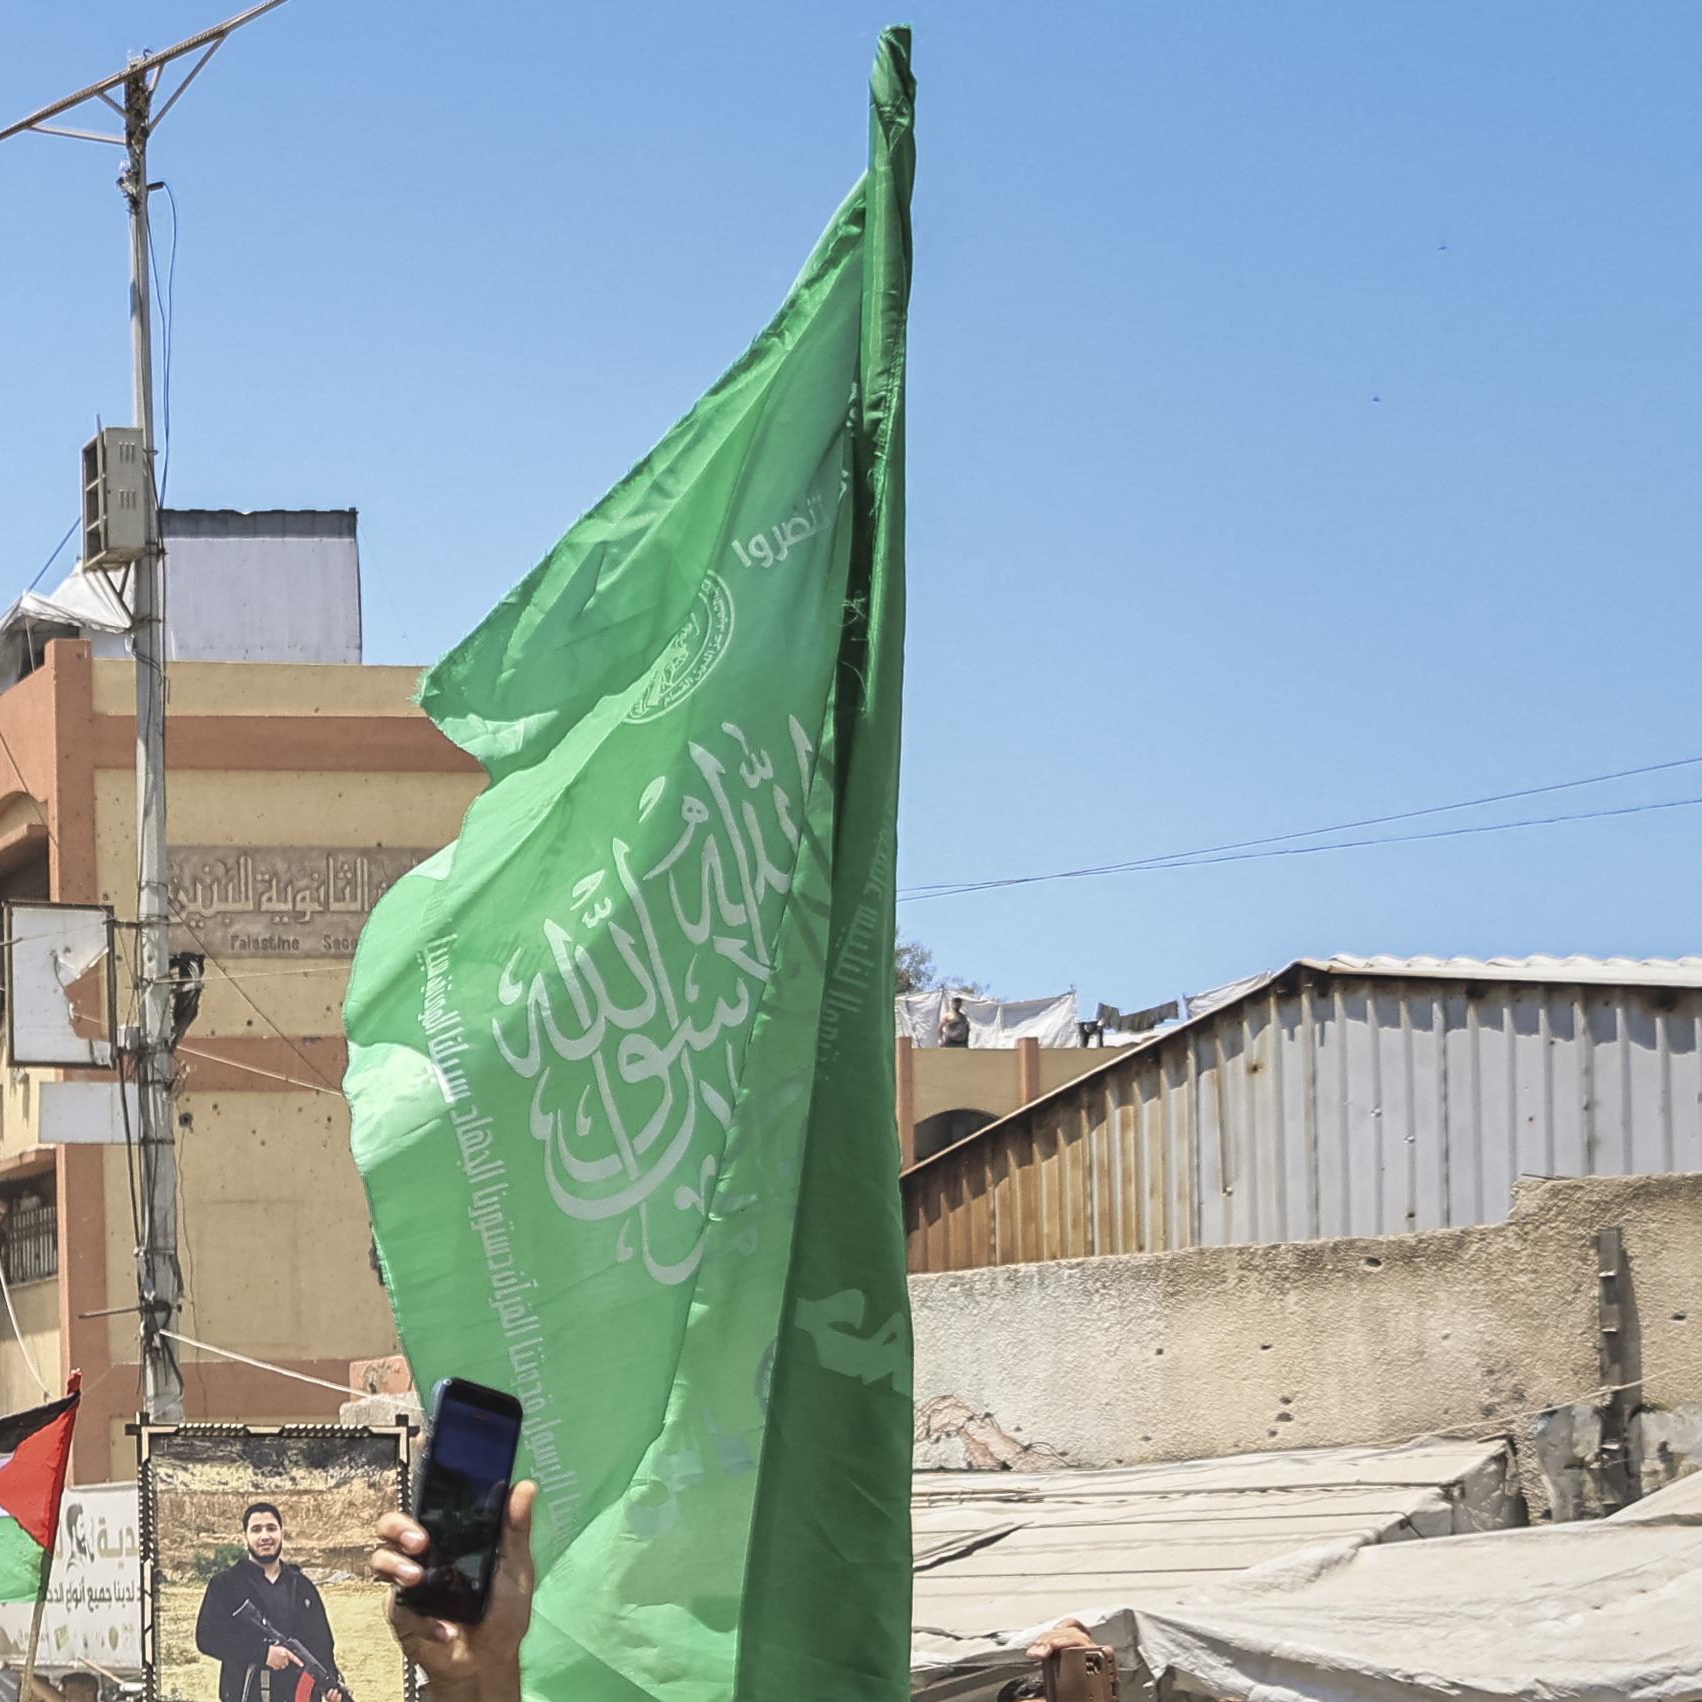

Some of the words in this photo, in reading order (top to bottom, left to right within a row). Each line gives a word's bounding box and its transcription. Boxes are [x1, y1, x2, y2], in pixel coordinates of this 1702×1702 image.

[256, 854, 369, 924] الثانوية
[229, 934, 300, 951] Palestine
[322, 934, 359, 951] Seco
[451, 1104, 507, 1183] الجهاد
[468, 1184, 515, 1271] دستورنا
[65, 1574, 86, 1614] أنواع
[86, 1585, 112, 1614] جميع
[113, 1579, 136, 1609] لدينا
